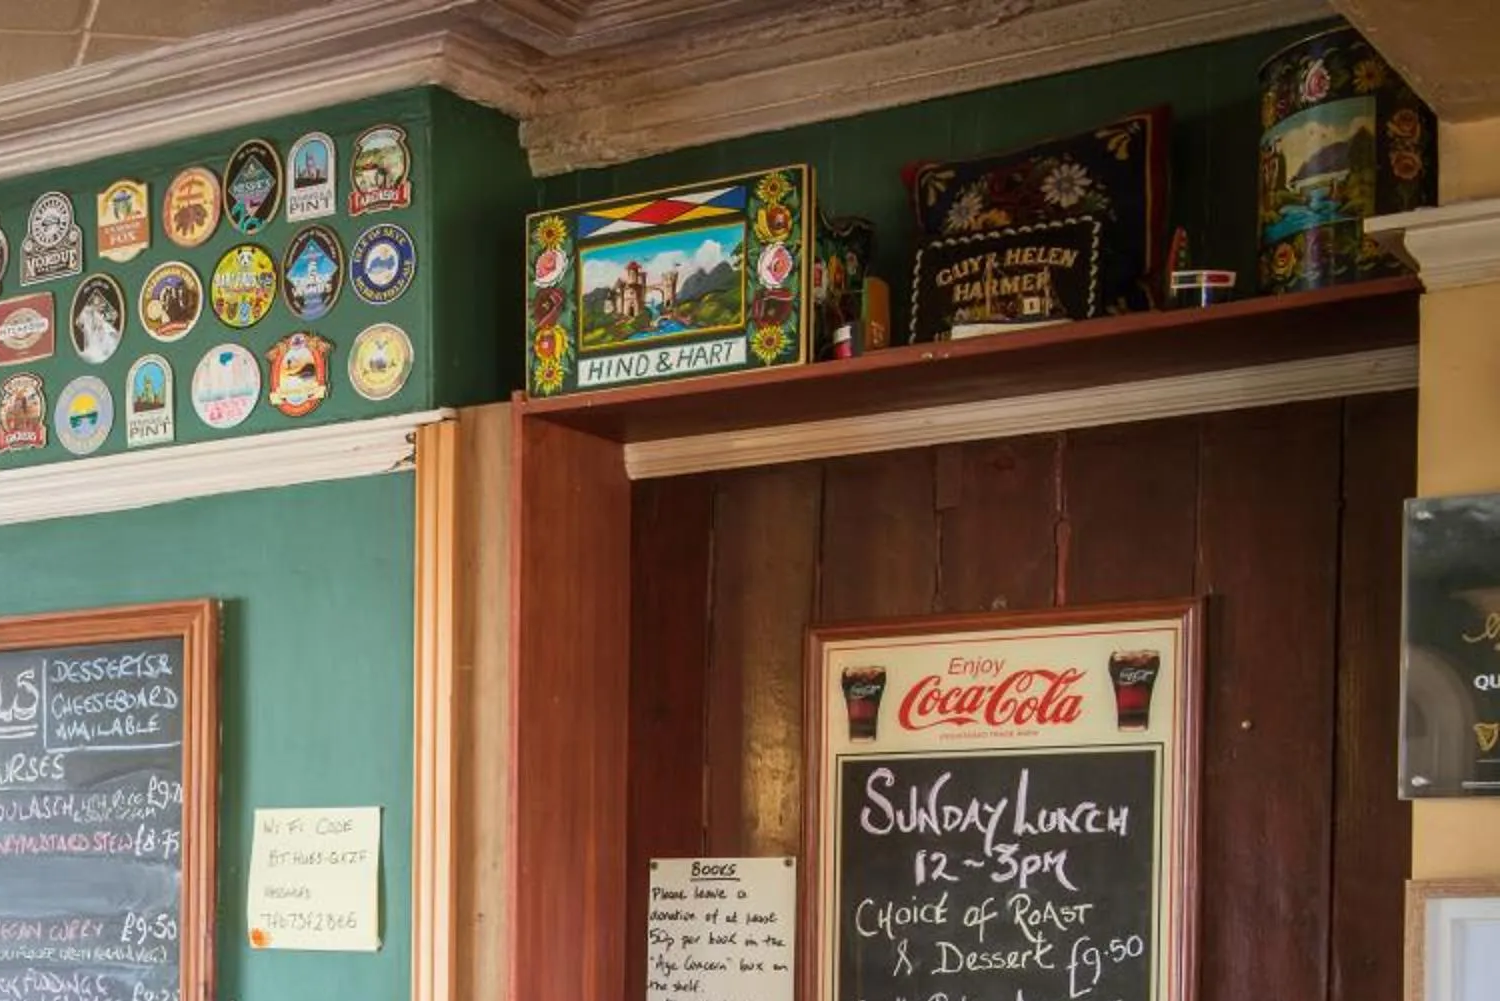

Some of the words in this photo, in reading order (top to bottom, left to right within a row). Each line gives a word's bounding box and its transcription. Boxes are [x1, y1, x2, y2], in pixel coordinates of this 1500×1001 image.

[936, 256, 984, 286] GUY
[1004, 246, 1080, 269] HELEN
[588, 350, 649, 381] HIND
[657, 353, 675, 373] &
[676, 341, 736, 369] HART
[129, 422, 170, 438] PINT
[948, 657, 1005, 679] Enjoy
[51, 684, 178, 721] CHEESEBOARD
[897, 667, 1089, 732] Coca-Cola
[55, 714, 161, 741] AVAILABLE
[860, 766, 1008, 857] SUNDAY
[1013, 768, 1130, 837] LUNCH
[691, 862, 737, 877] BOOKS
[651, 887, 687, 900] Please
[694, 887, 727, 899] leave
[737, 891, 747, 899] a
[120, 912, 177, 944] £9.50
[650, 910, 695, 922] donation
[705, 909, 719, 924] of
[963, 897, 998, 943] of
[681, 935, 700, 949] per
[709, 932, 737, 945] book
[763, 934, 786, 947] the
[739, 957, 764, 971] box
[930, 931, 1056, 976] Dessert
[1066, 934, 1144, 1000] £9.50
